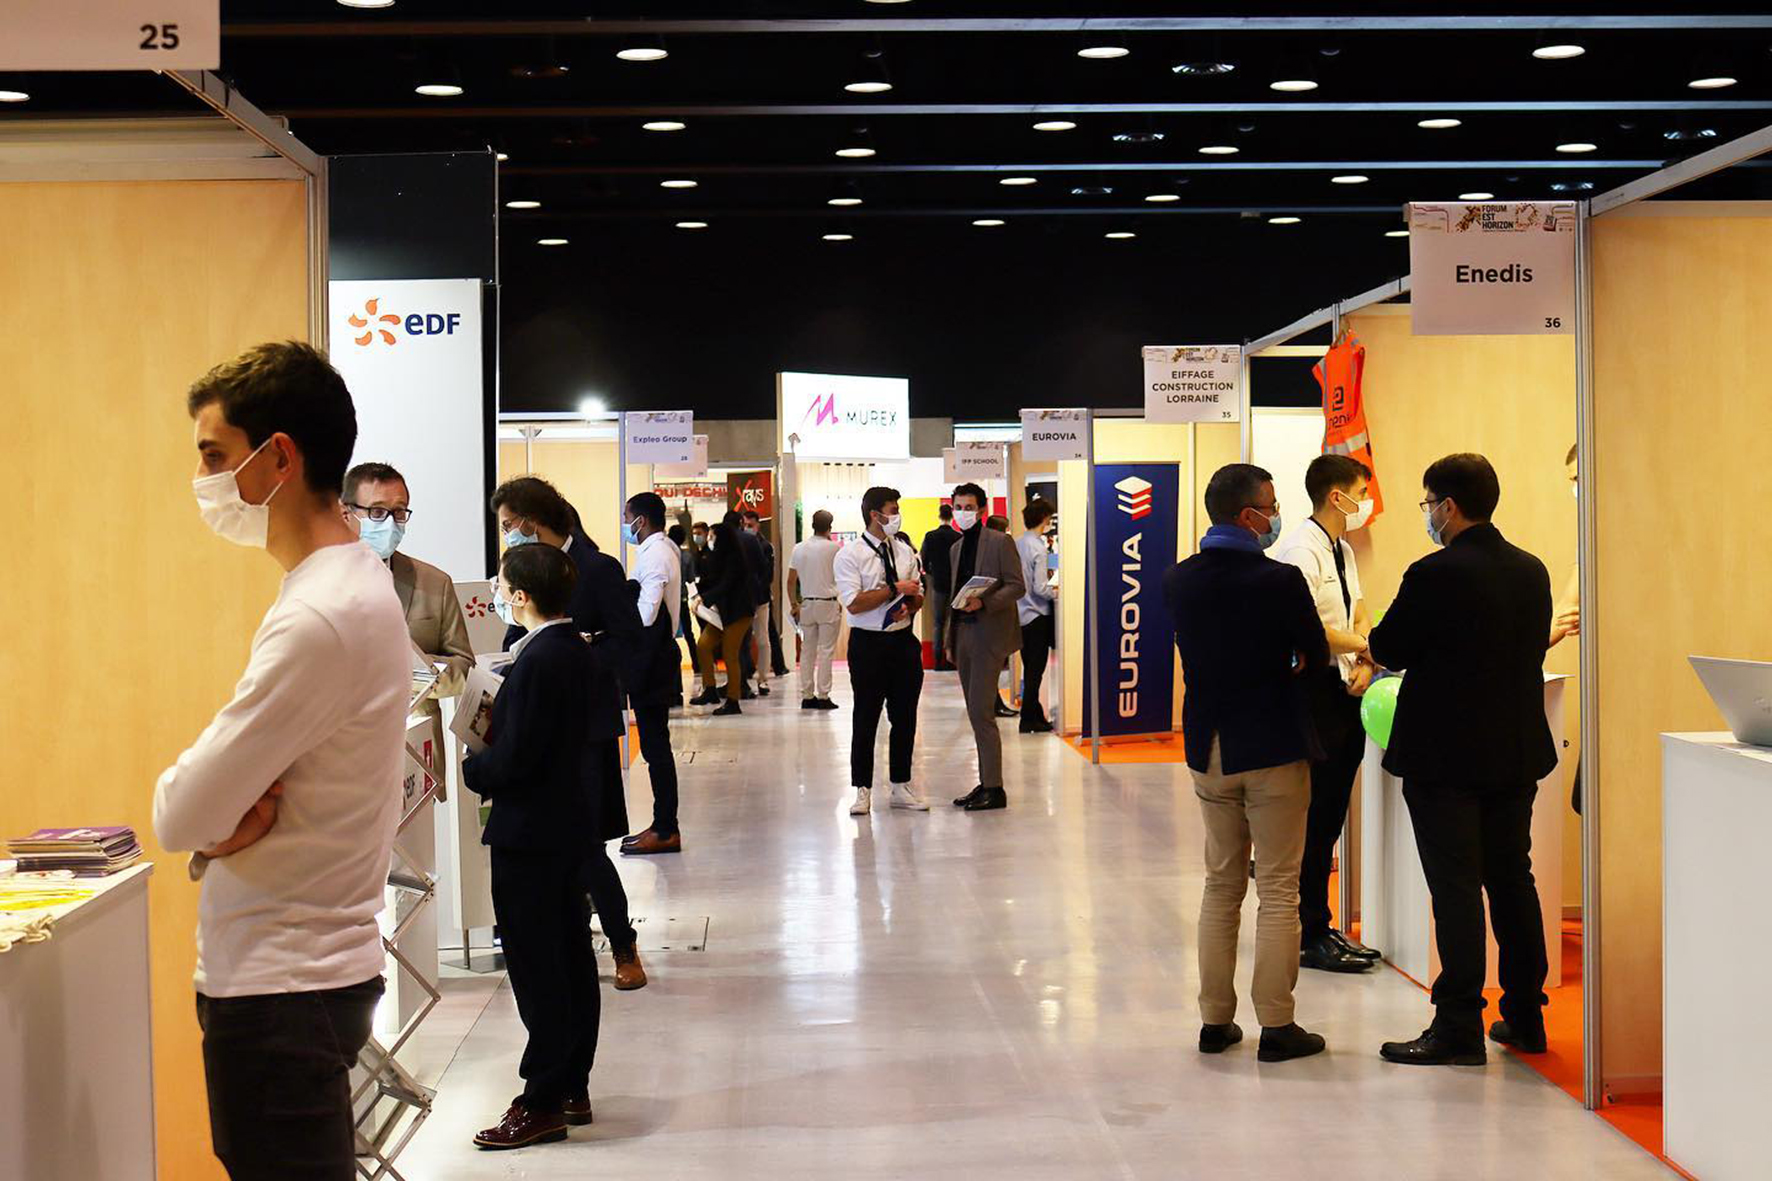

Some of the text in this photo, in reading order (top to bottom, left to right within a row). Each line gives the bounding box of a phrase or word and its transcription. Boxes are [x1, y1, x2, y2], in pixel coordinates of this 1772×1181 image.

[140, 24, 179, 50] 25
[1482, 221, 1514, 229] HORIZON
[1456, 264, 1533, 283] Enedis
[1545, 317, 1561, 328] 36
[1171, 371, 1215, 379] EIFFAGE
[1152, 382, 1234, 391] CONSTRUCTION
[1166, 395, 1219, 403] LORRAINE
[846, 410, 897, 426] MUREX
[1032, 433, 1077, 441] EUROVIA
[1118, 532, 1143, 718] EUROVIA
